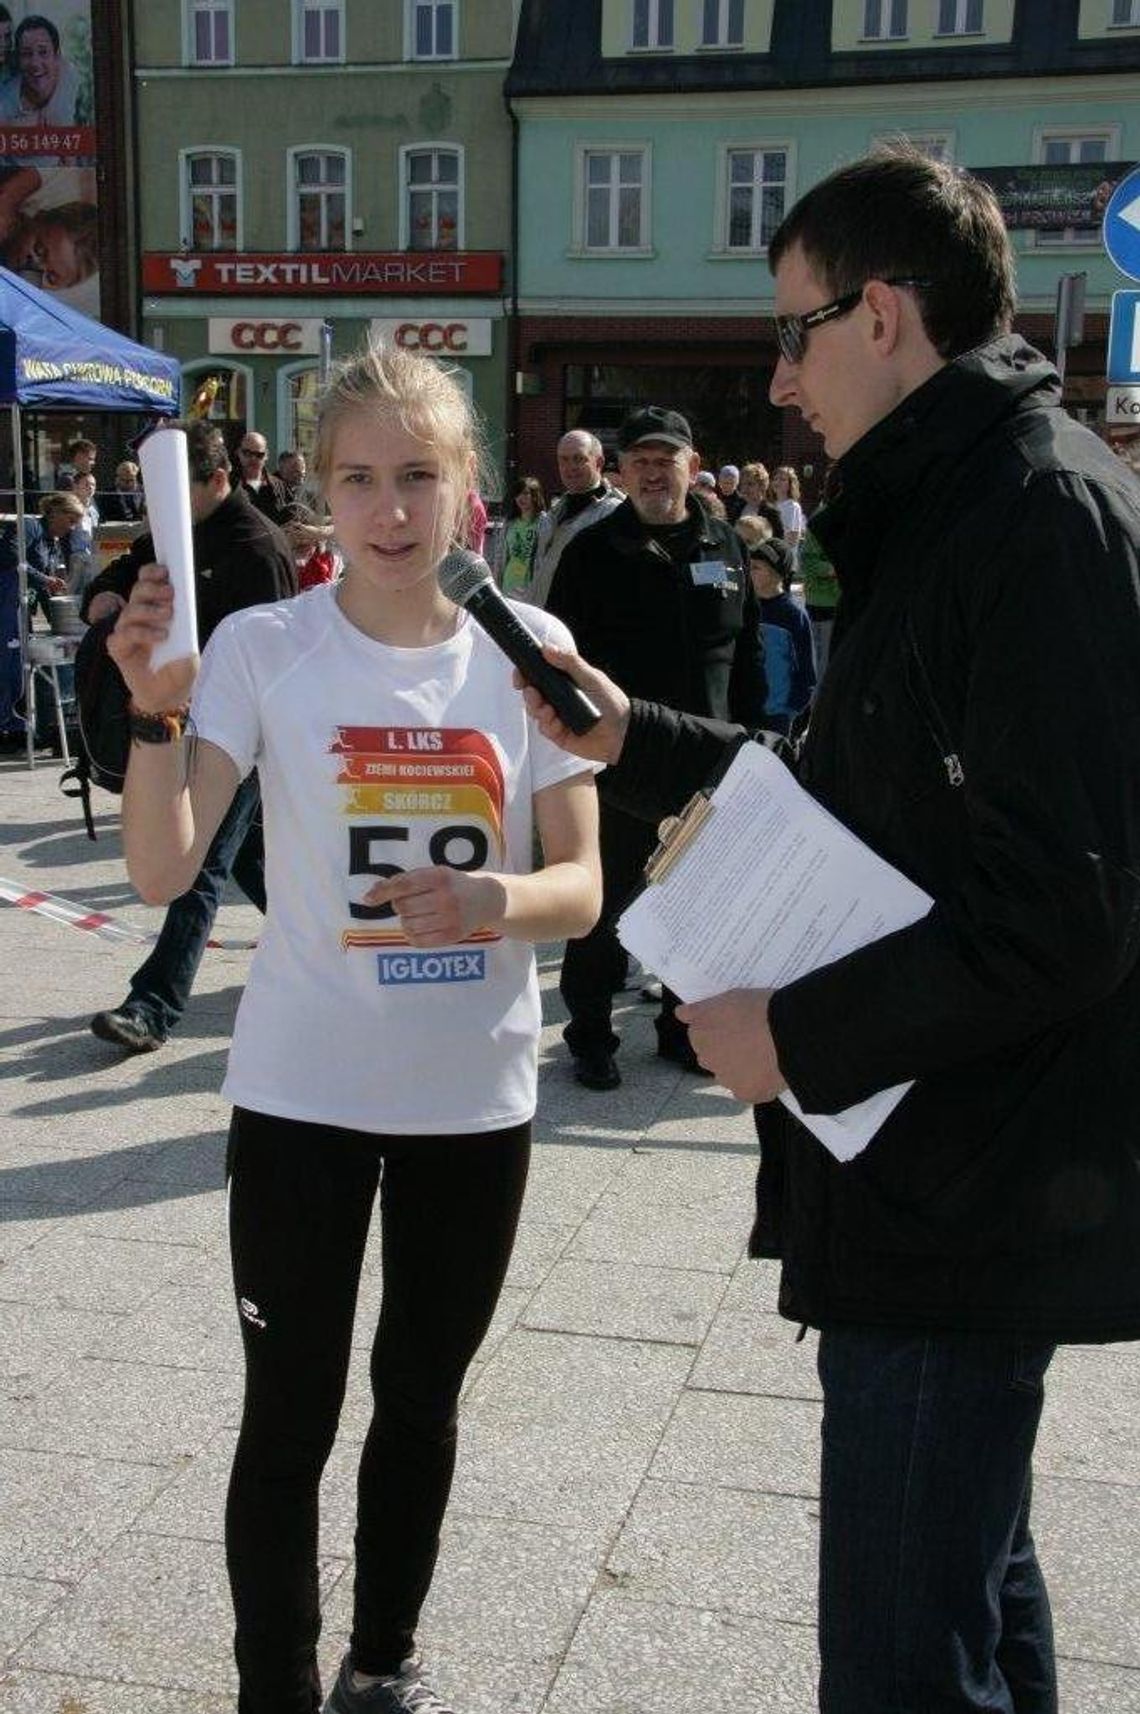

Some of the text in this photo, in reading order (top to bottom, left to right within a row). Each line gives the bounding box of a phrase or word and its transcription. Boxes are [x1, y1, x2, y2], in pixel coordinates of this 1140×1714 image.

[10, 133, 29, 150] 56
[214, 262, 468, 284] TEXTILMARKET
[230, 322, 303, 350] CCC
[394, 323, 468, 351] CCC
[388, 731, 443, 750] L. LKS
[365, 763, 396, 776] ZIEMI
[383, 954, 482, 980] IGLOTEX
